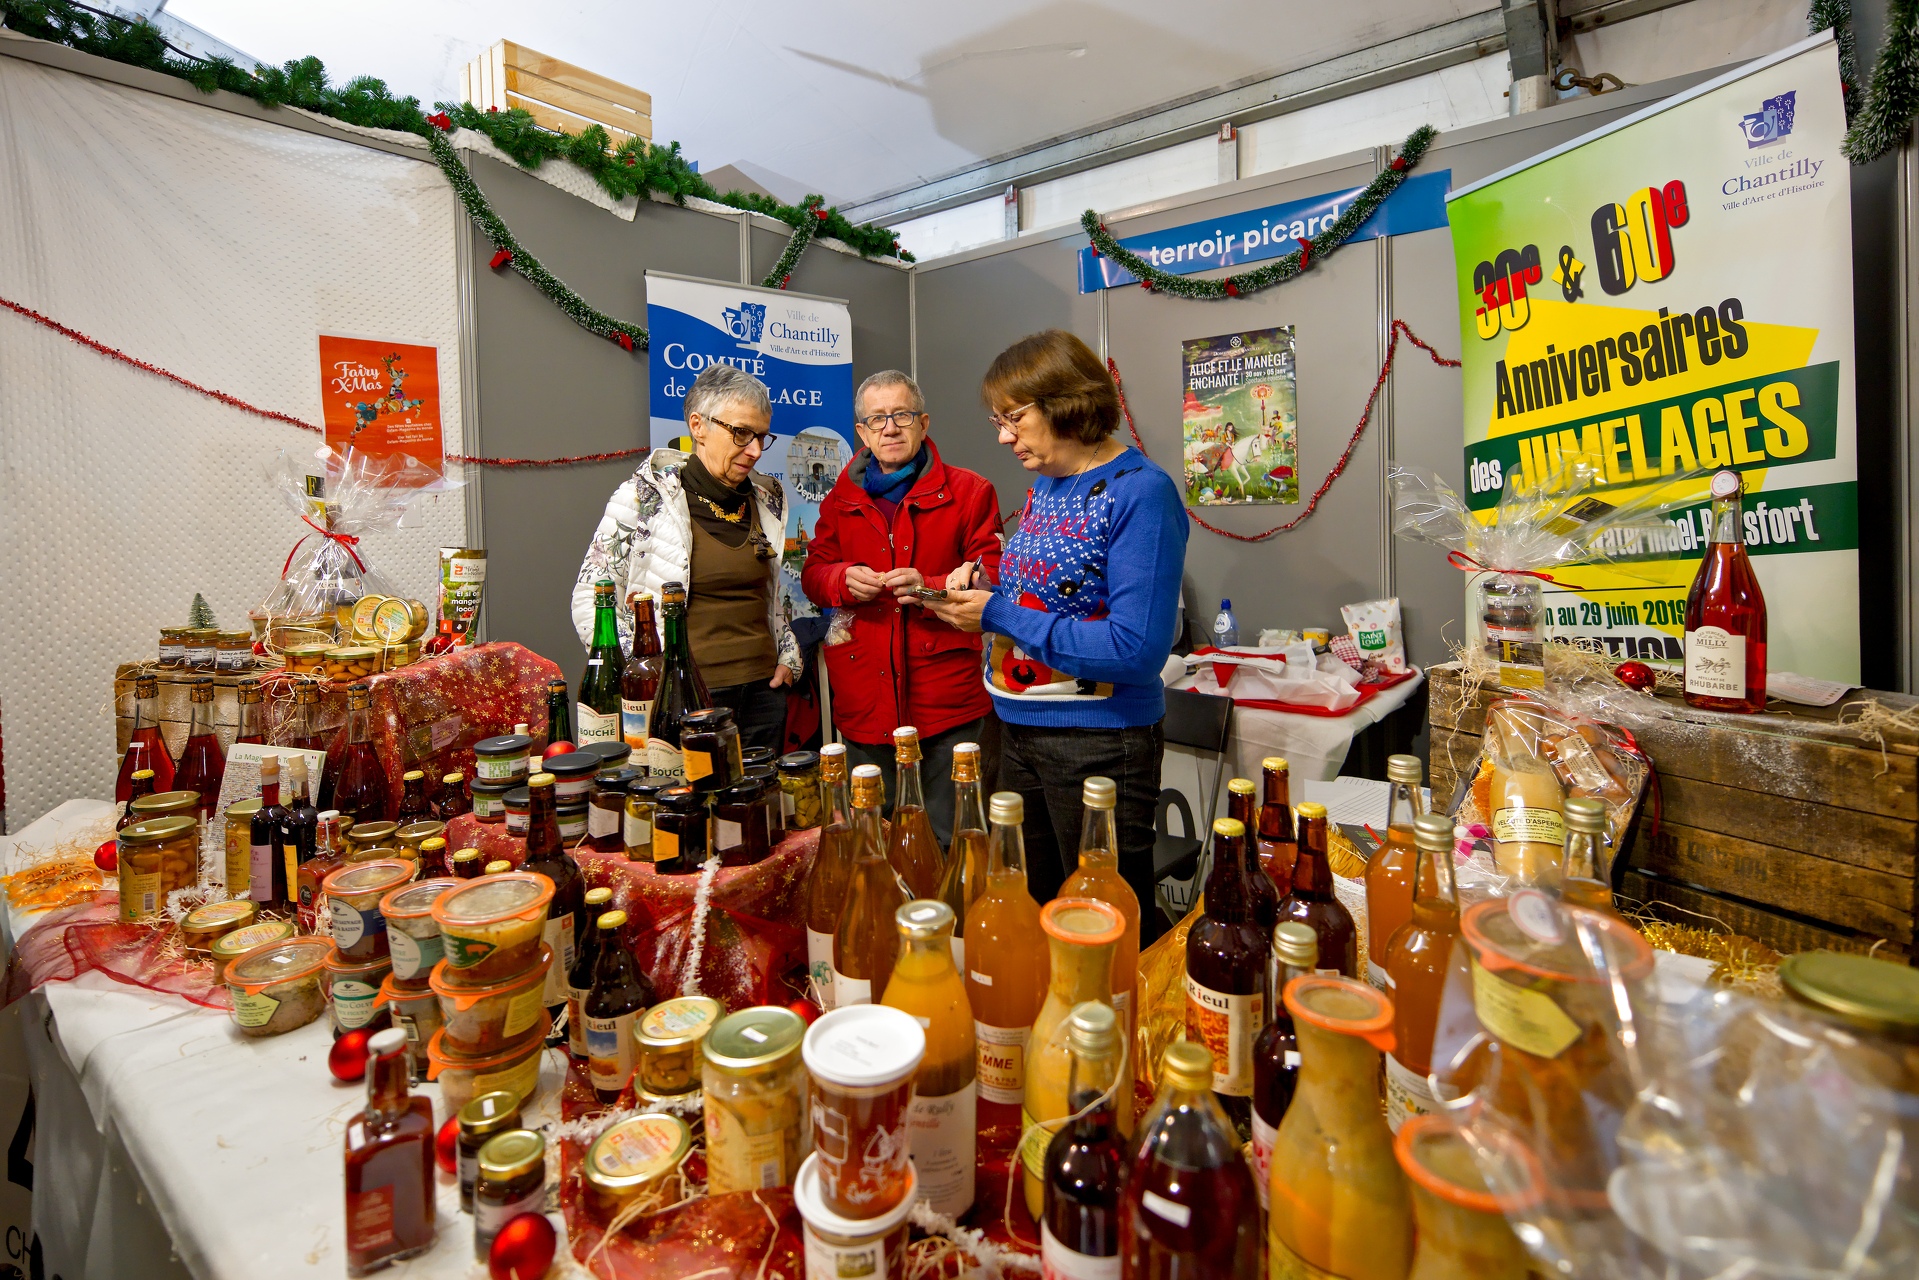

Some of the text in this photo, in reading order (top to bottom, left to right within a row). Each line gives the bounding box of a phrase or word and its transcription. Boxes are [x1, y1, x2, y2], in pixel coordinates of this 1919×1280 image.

[1744, 149, 1793, 169] Ville de
[1721, 157, 1825, 196] Chantilly
[1722, 180, 1825, 211] Ville d'Art et d'Histoire
[1149, 205, 1339, 267] terroir picard
[1558, 245, 1585, 303] &
[786, 309, 820, 323] Ville de
[769, 322, 840, 348] Chantilly
[769, 344, 784, 354] Ville
[784, 345, 800, 355] d'Art
[809, 348, 841, 358] d'Histoire
[1495, 297, 1749, 420] Anniversaires
[333, 361, 380, 380] Fairy
[1189, 352, 1288, 377] ALICE ET LE MANÈGE
[331, 378, 383, 394] X-Mas
[663, 376, 686, 398] de
[1190, 370, 1240, 391] ENCHANTÉ
[1469, 381, 1810, 494] des JUMELAGES
[795, 482, 826, 502] Depuis
[1554, 605, 1577, 626] au
[1580, 602, 1603, 626] 29
[1605, 601, 1640, 630] juin
[1643, 599, 1686, 626] 2019
[1360, 631, 1384, 640] SAINT
[1361, 639, 1384, 647] LOUIS
[1696, 638, 1728, 647] MILLY
[1689, 679, 1739, 691] RHUBARBE
[579, 726, 616, 737] BOUCHÉ
[234, 752, 262, 762] La Magi
[652, 768, 685, 777] BOUCH
[1189, 981, 1230, 1010] Rieul
